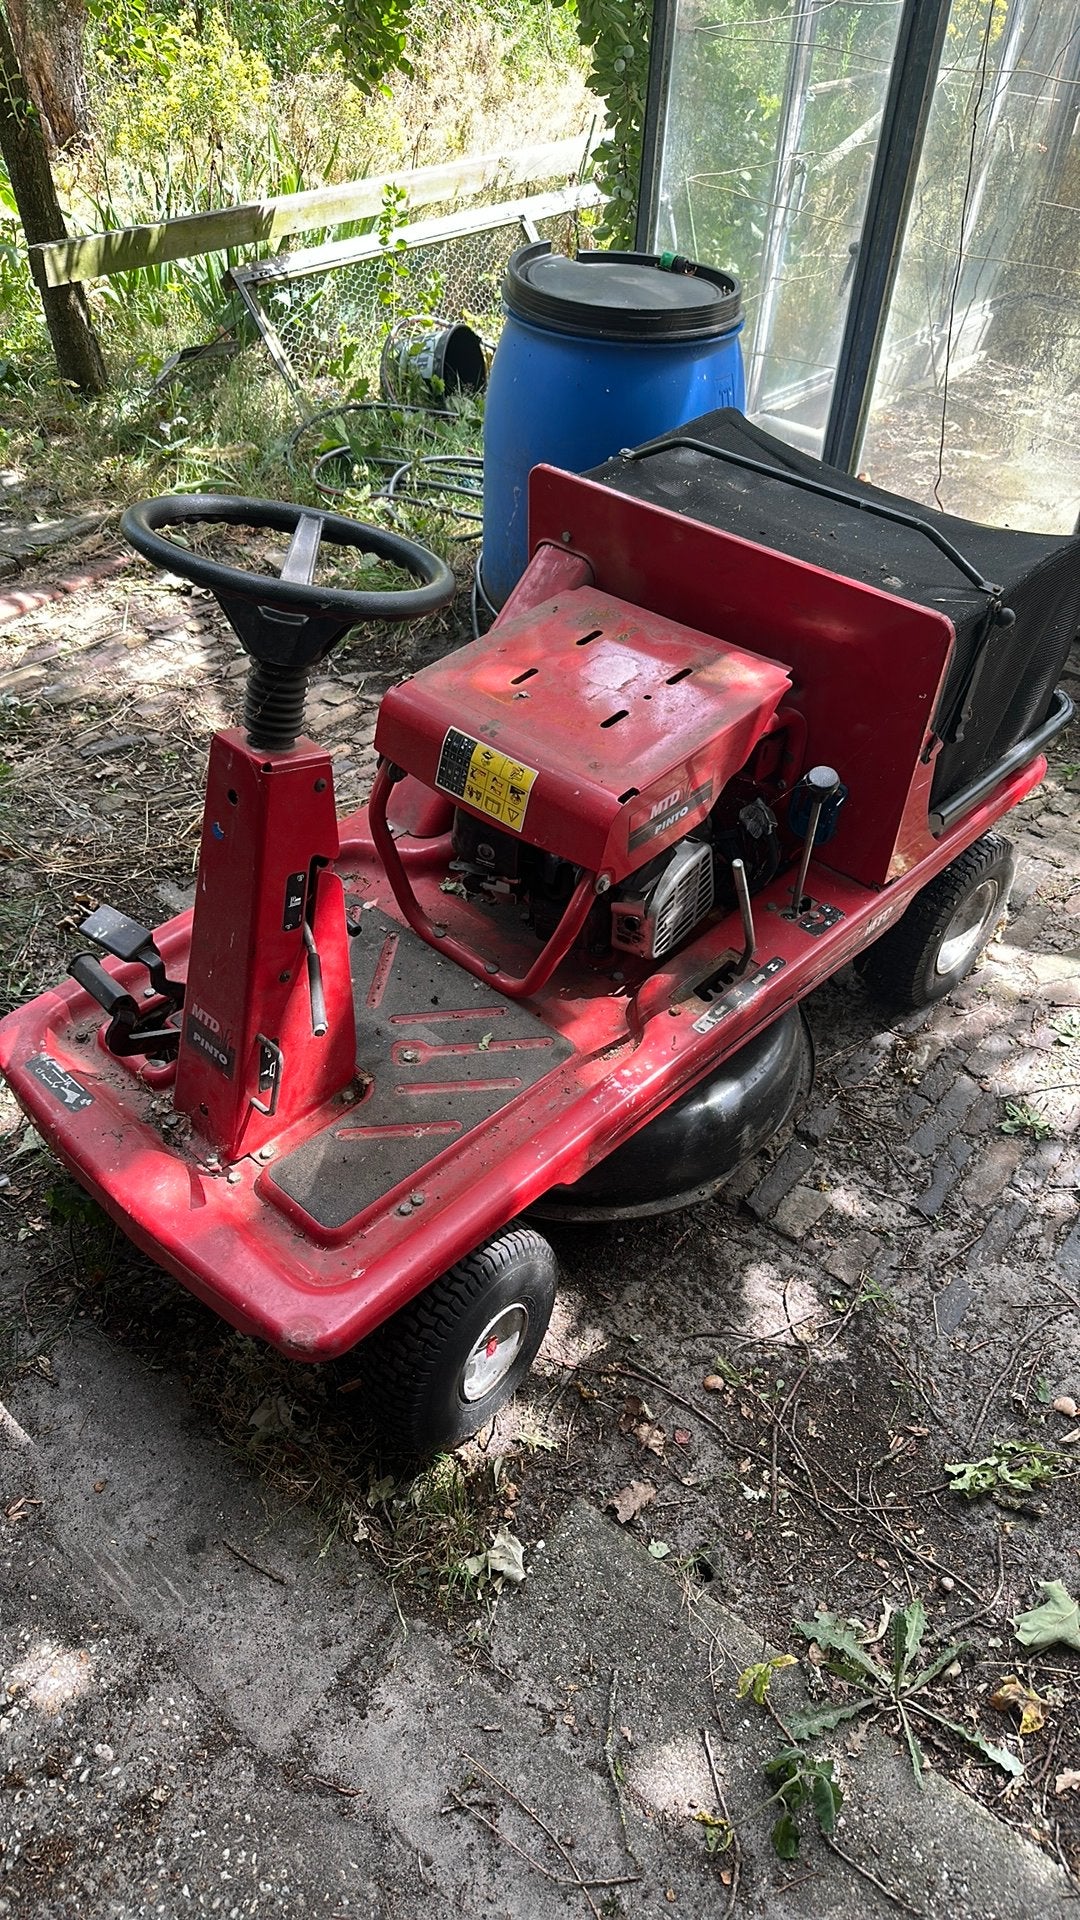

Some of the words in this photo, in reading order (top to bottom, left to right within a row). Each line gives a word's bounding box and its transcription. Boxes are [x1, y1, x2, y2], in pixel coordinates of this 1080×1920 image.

[650, 790, 680, 820] MTD
[654, 806, 689, 835] PINTO
[191, 1003, 220, 1032] MTD
[193, 1032, 228, 1065] PINTO
